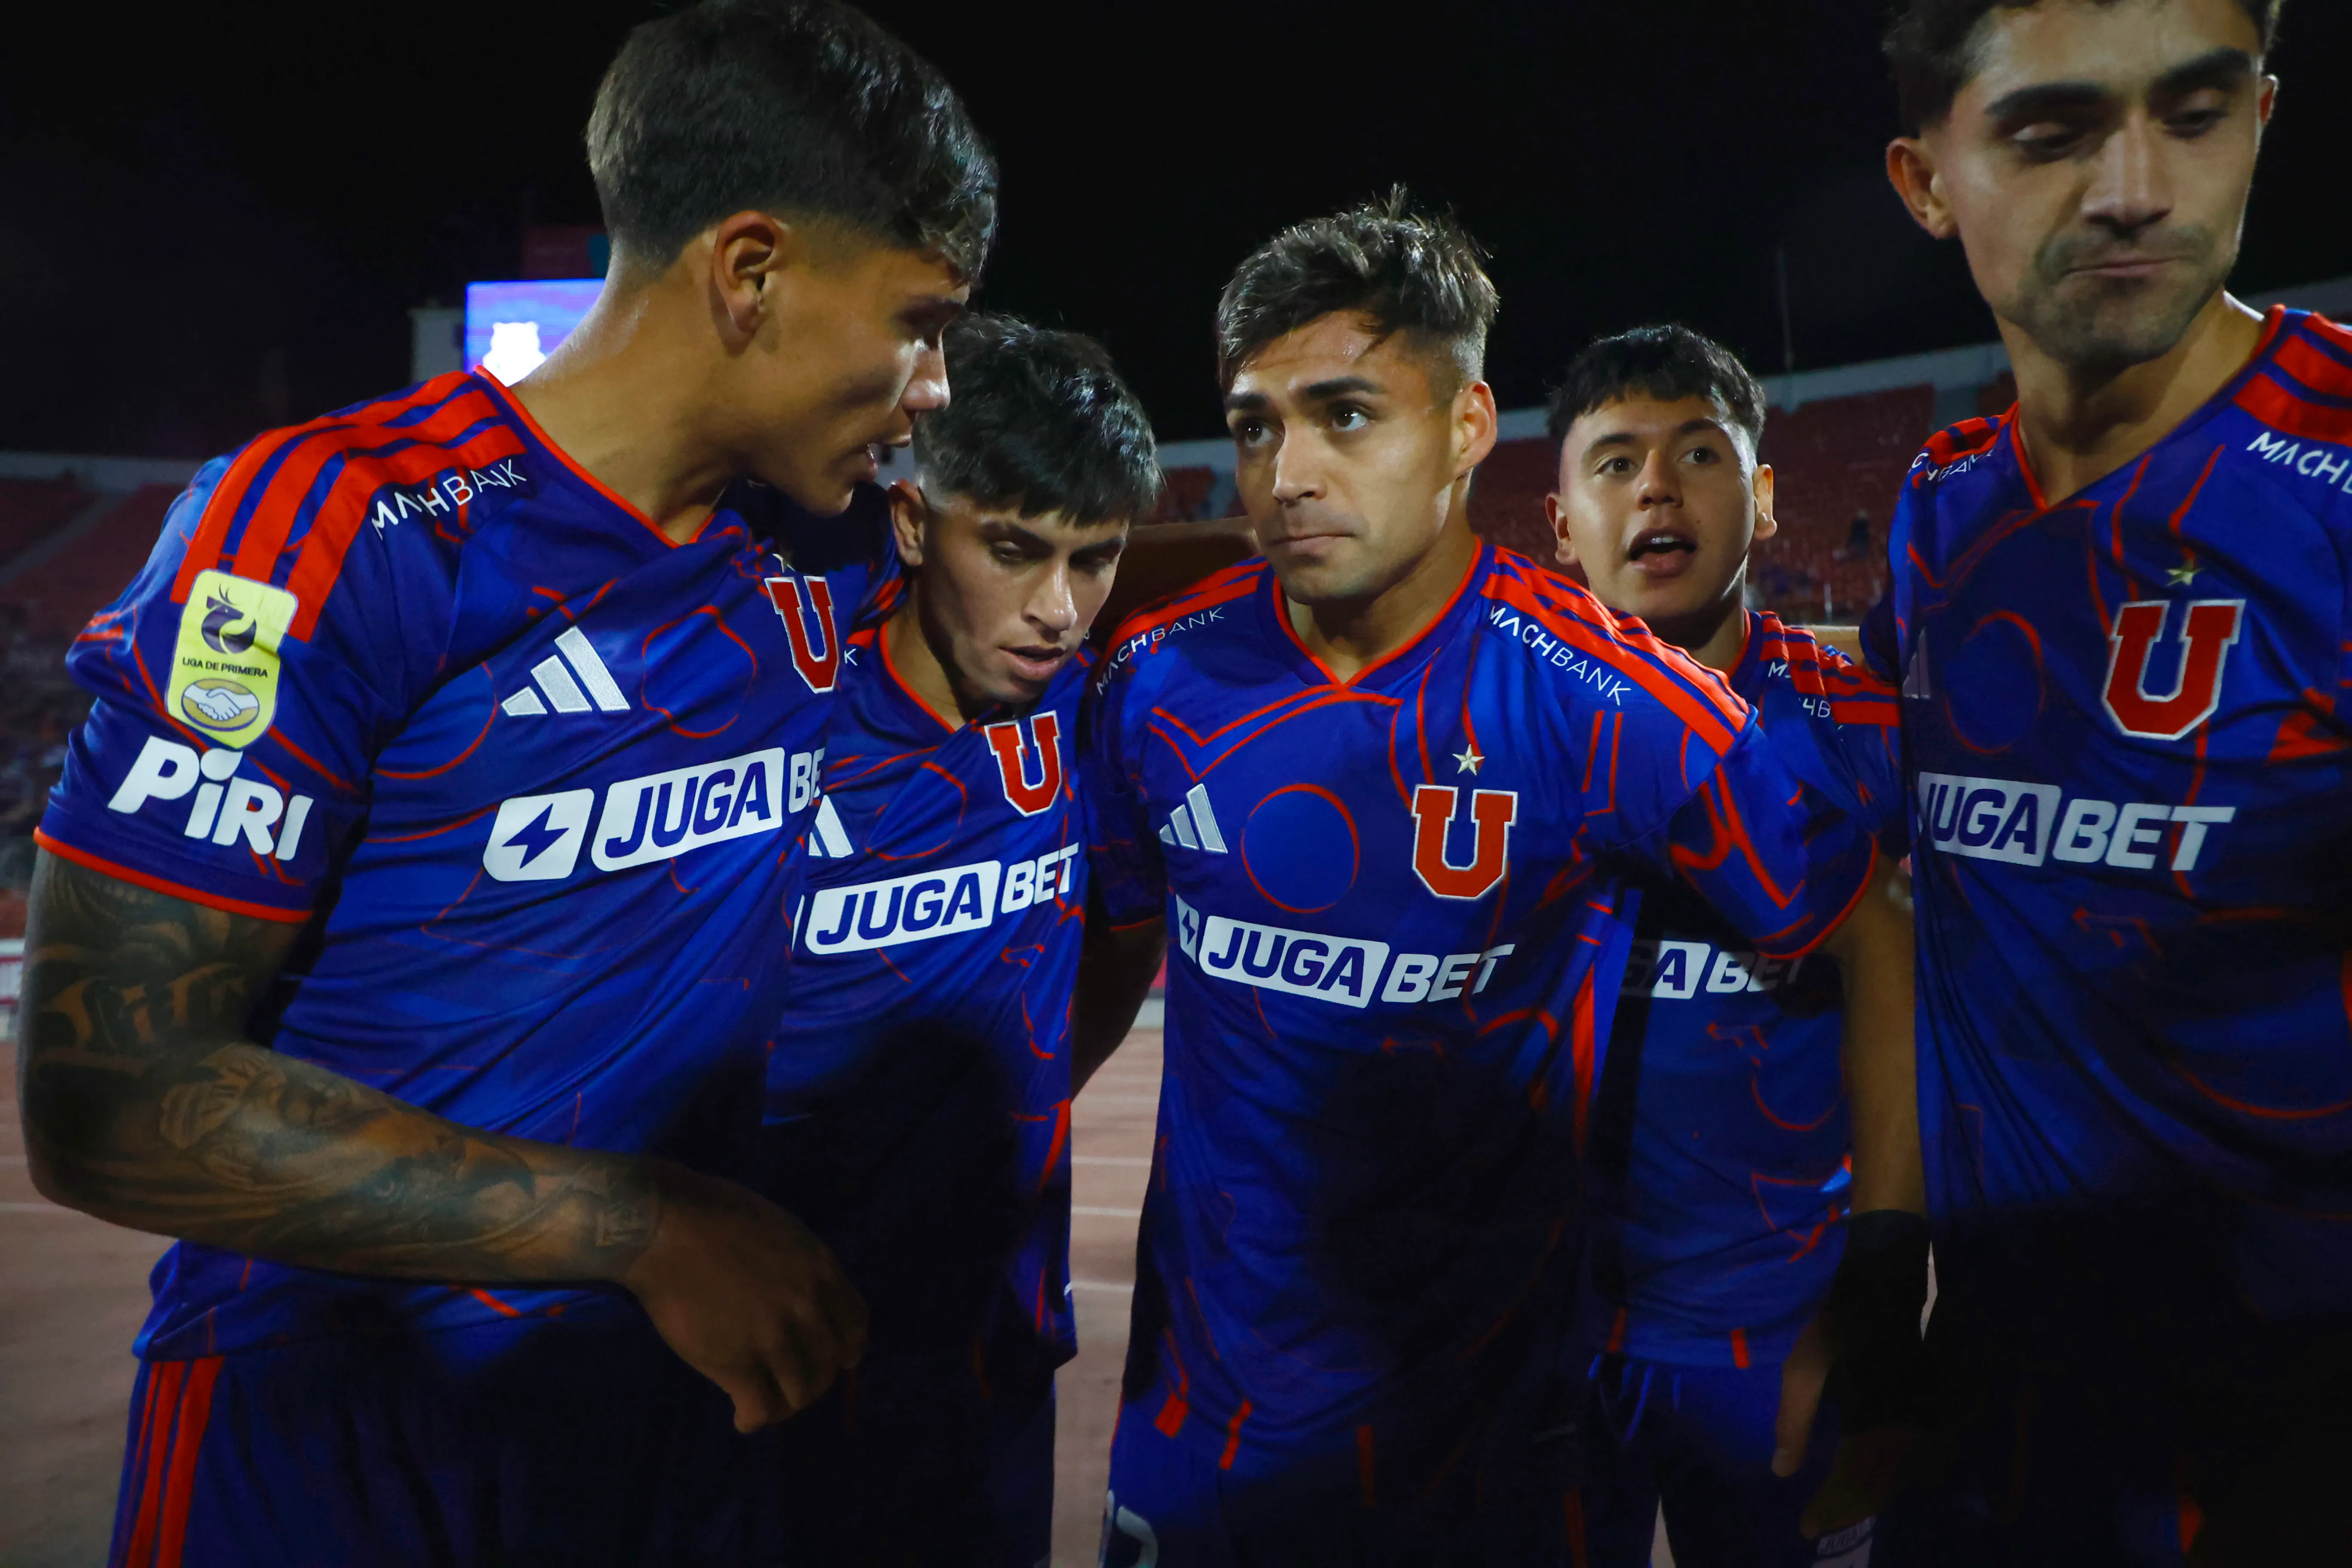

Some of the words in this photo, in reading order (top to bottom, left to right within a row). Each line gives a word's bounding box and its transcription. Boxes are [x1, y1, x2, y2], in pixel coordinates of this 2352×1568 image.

[182, 656, 203, 668] LIGA
[205, 660, 219, 671] DE
[220, 662, 268, 678] PRIMERA
[765, 576, 839, 694] U
[1096, 607, 1225, 695] MACHBANK
[1489, 605, 1632, 706] MACHBANK
[2102, 599, 2246, 741] U
[985, 710, 1062, 817] U
[1411, 784, 1518, 900] U
